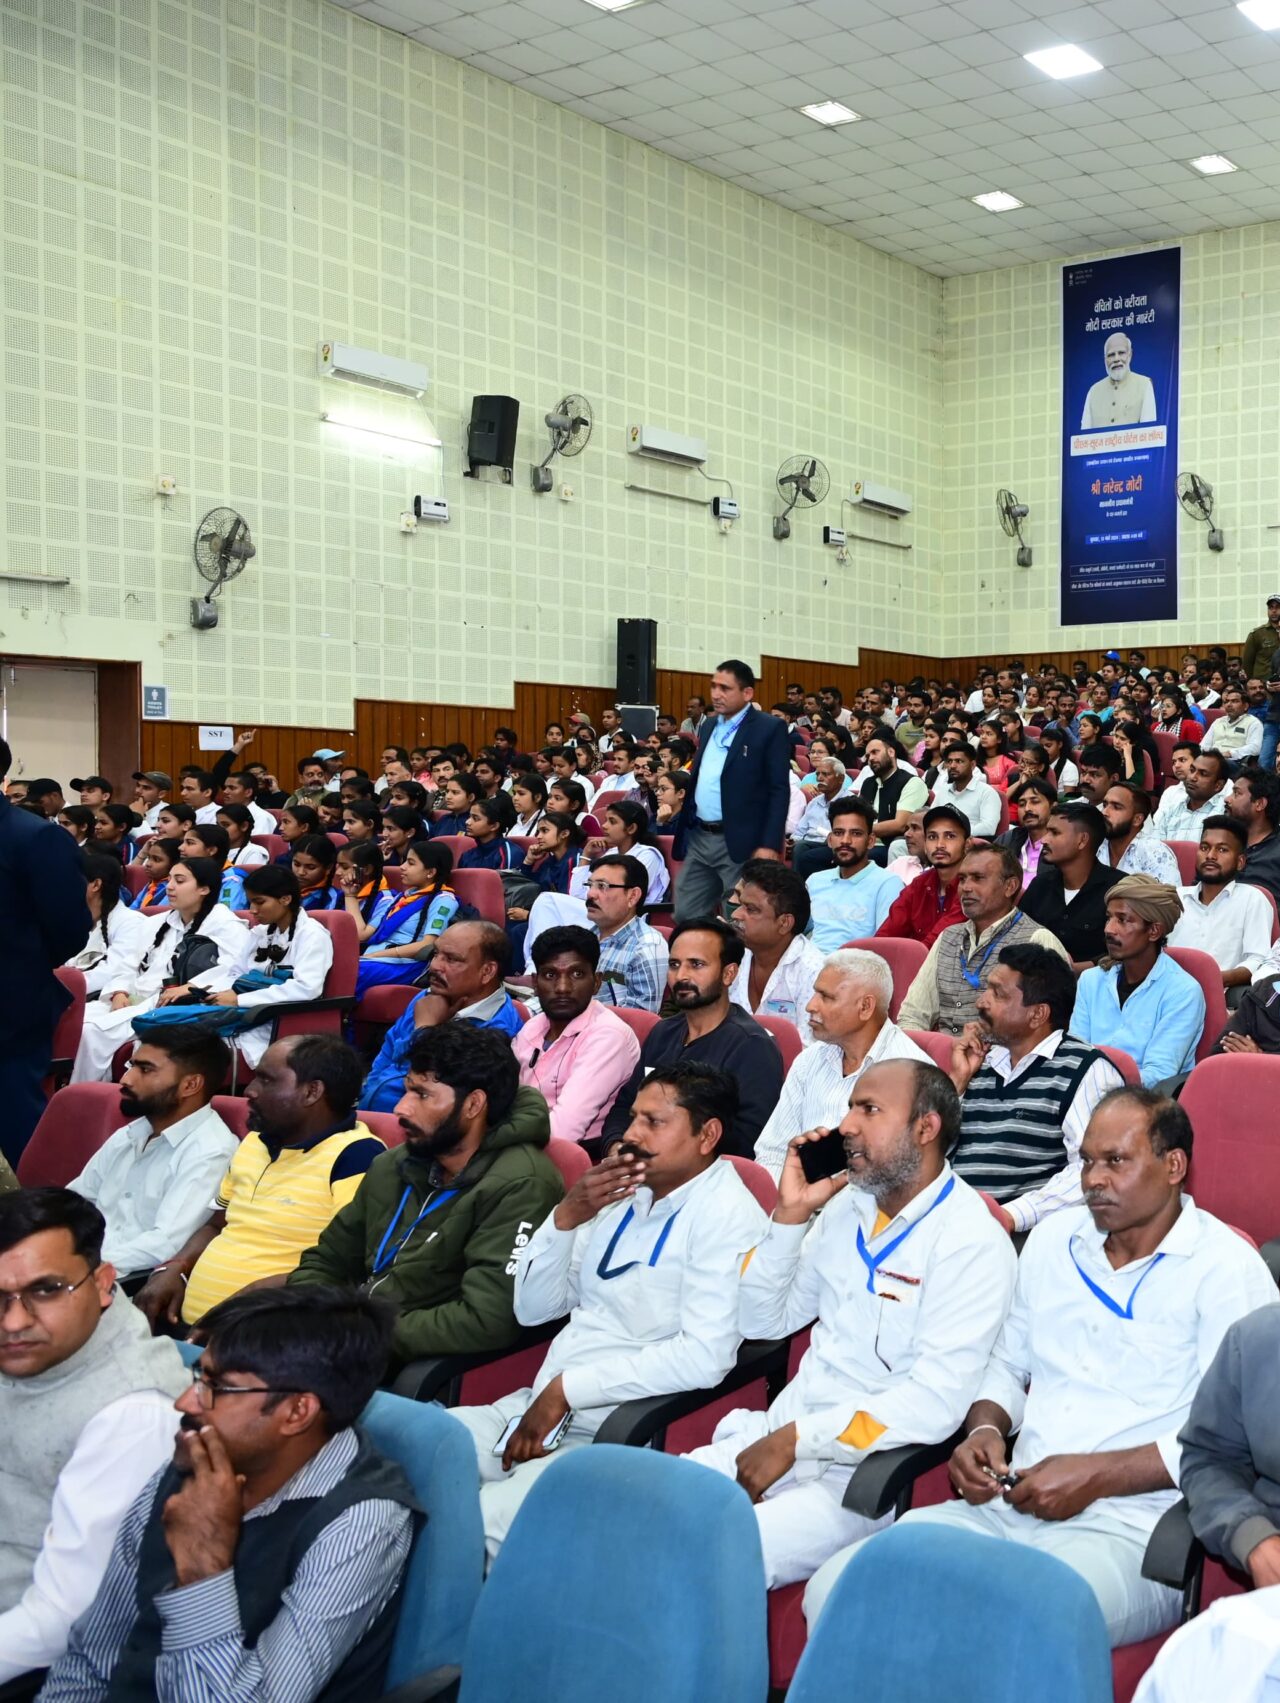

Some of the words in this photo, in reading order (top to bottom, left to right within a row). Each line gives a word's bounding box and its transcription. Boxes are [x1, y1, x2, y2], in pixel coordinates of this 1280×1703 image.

[1114, 296, 1122, 310] को
[1085, 317, 1100, 332] मोदी
[1101, 316, 1123, 330] सरकार
[1125, 312, 1134, 326] की
[1091, 479, 1100, 495] श्री
[1126, 474, 1142, 492] मोदी
[208, 730, 224, 738] SST
